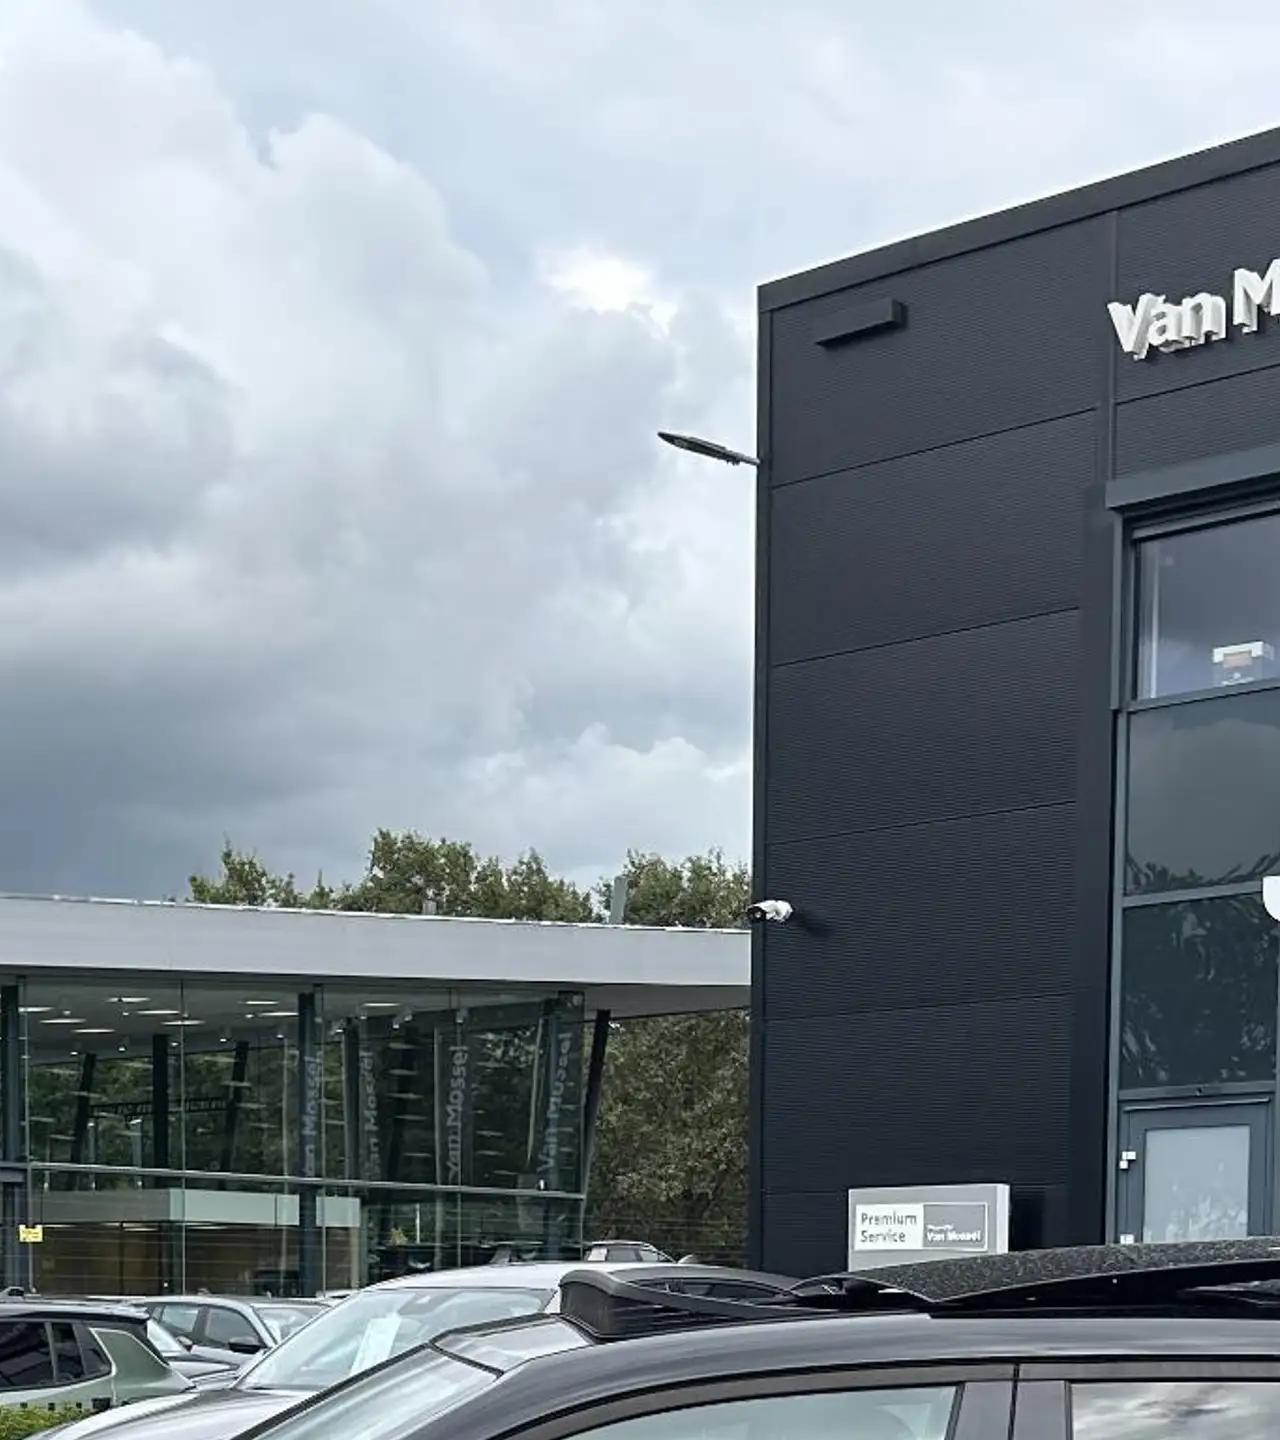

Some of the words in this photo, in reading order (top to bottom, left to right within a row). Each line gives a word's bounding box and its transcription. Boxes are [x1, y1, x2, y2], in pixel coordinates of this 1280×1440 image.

[1107, 292, 1226, 361] Van
[446, 1045, 469, 1127] Mossel
[860, 1210, 918, 1226] Premium
[860, 1229, 907, 1244] Service
